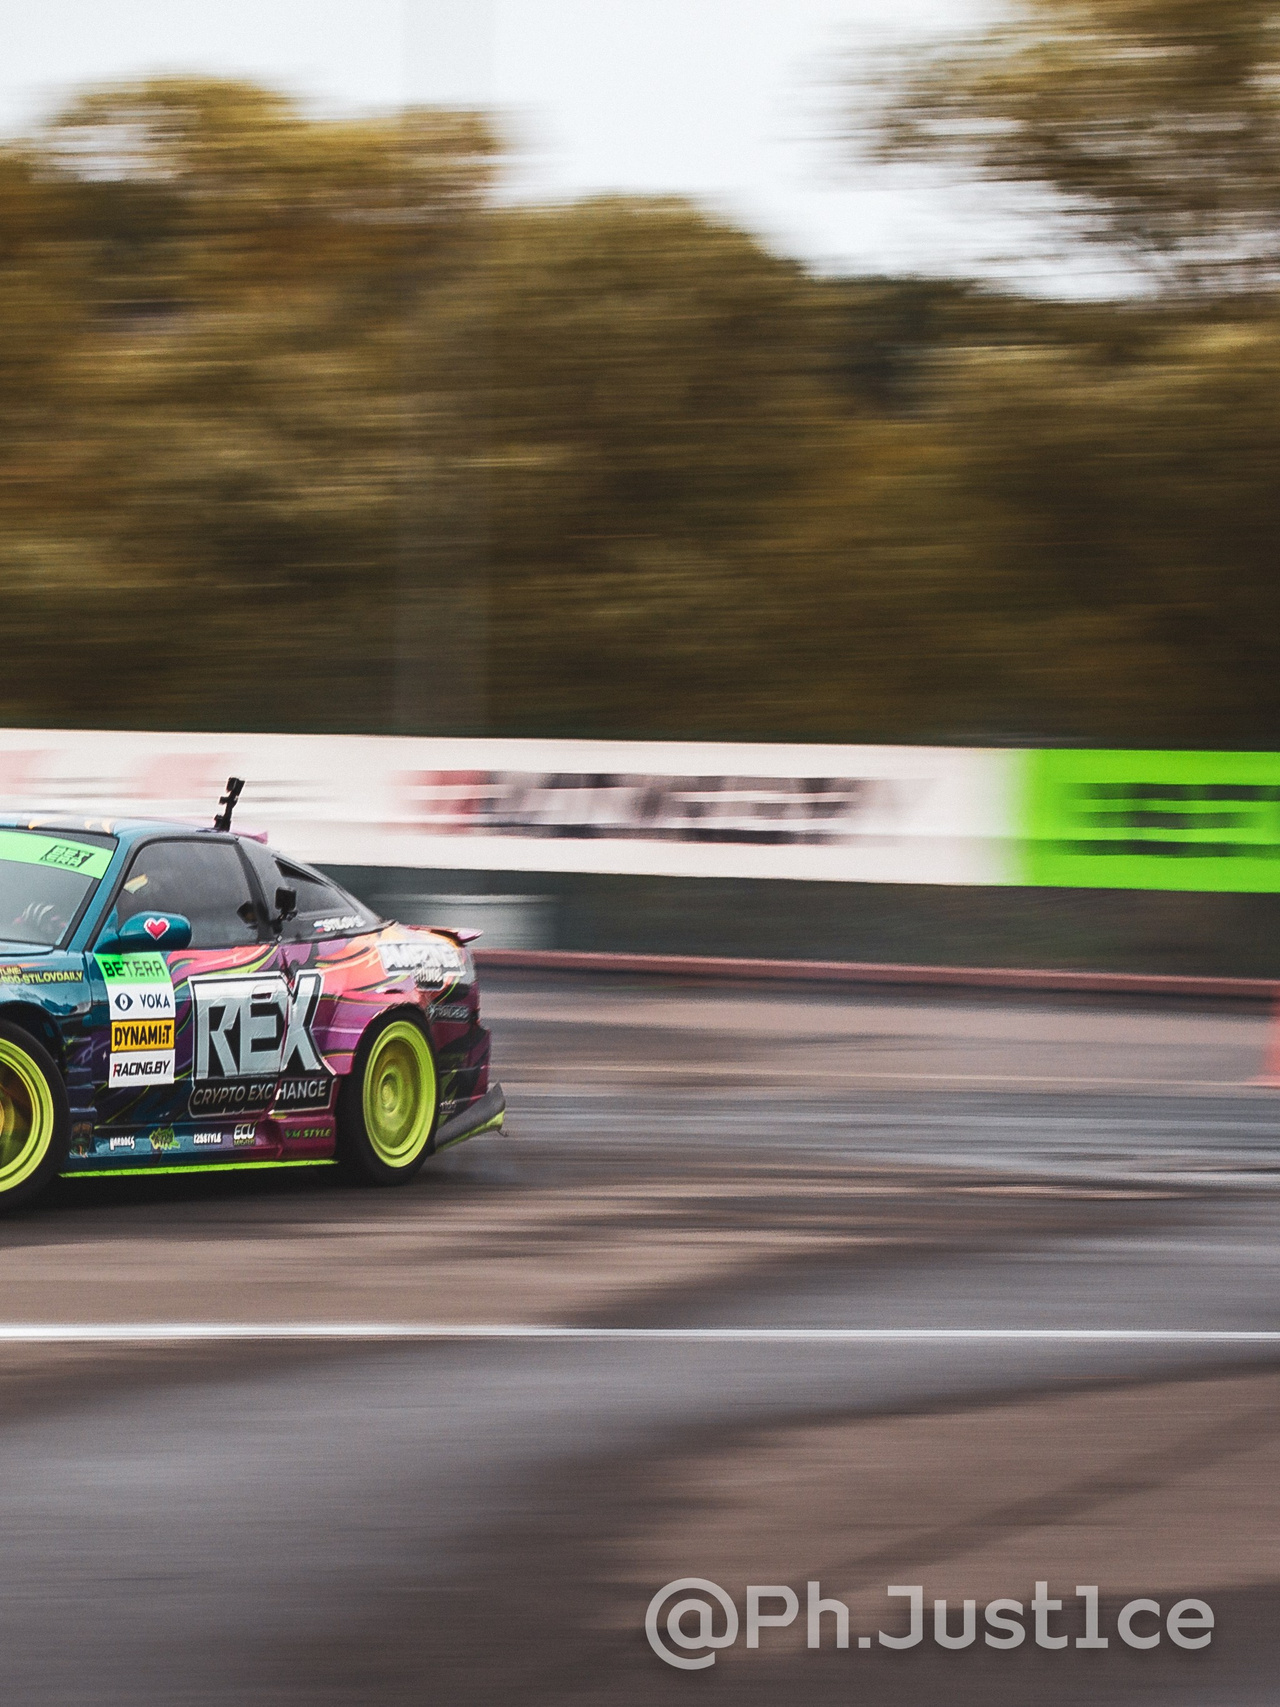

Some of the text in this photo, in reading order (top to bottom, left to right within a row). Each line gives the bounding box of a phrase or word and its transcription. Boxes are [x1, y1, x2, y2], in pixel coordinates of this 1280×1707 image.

[102, 960, 165, 978] BETERA
[140, 993, 171, 1009] VOKA
[192, 973, 324, 1079] REX
[113, 1060, 171, 1077] RACING.BY
[193, 1080, 327, 1106] CRYPTO EXCHANGE
[234, 1123, 256, 1139] ECU
[303, 1128, 332, 1139] STYLE
